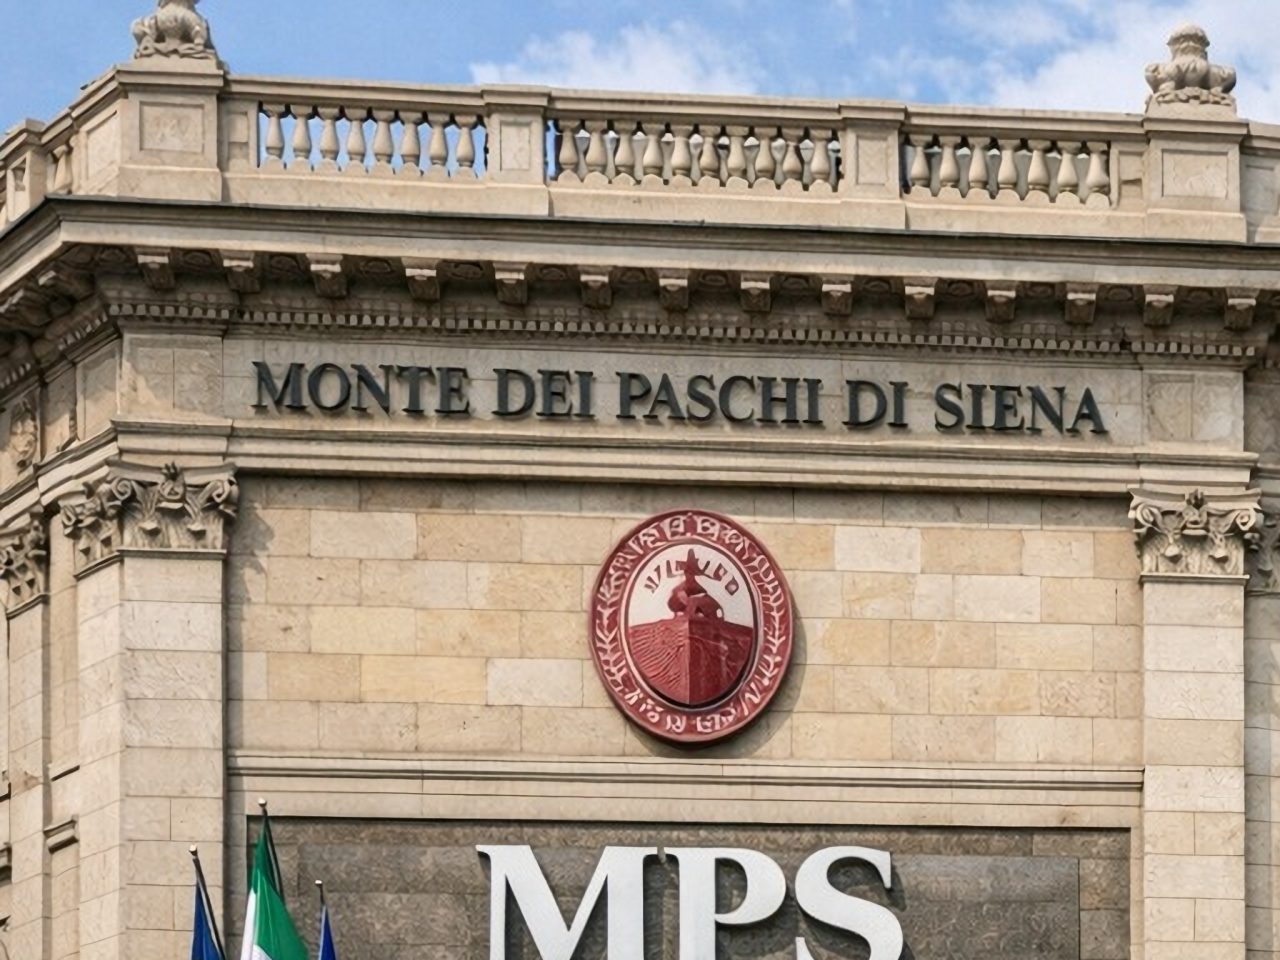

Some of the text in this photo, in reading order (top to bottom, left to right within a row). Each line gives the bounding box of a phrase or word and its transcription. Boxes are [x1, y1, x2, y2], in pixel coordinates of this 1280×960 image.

[251, 361, 1109, 435] MONTE DEI PASCHI DI SIENA
